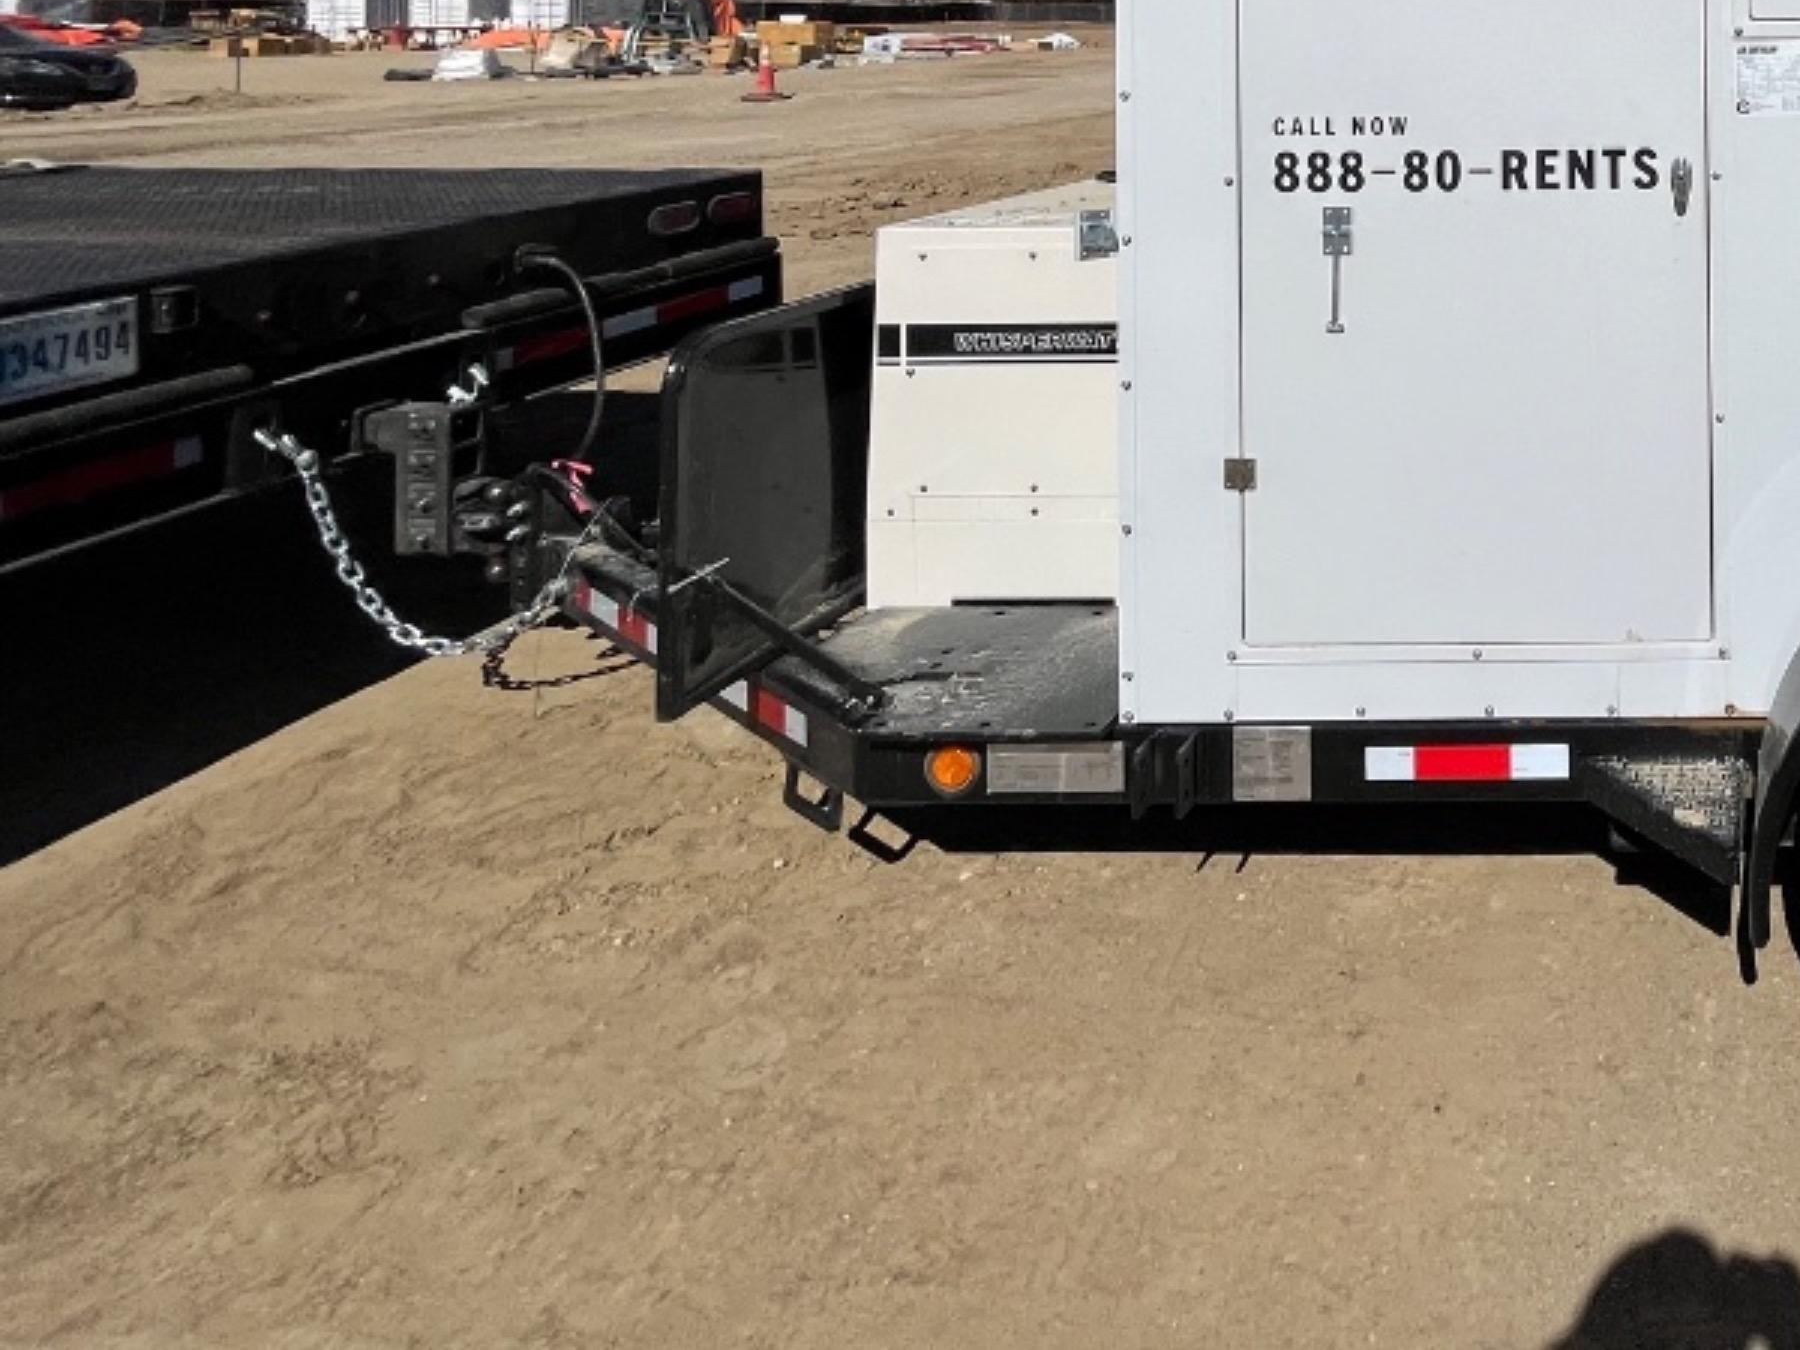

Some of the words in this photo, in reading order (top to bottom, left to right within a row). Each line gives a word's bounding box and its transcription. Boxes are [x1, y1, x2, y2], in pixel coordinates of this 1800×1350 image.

[1273, 116, 1337, 136] CALL
[1352, 116, 1408, 136] NOW
[1273, 148, 1660, 193] 888-80-RENTS
